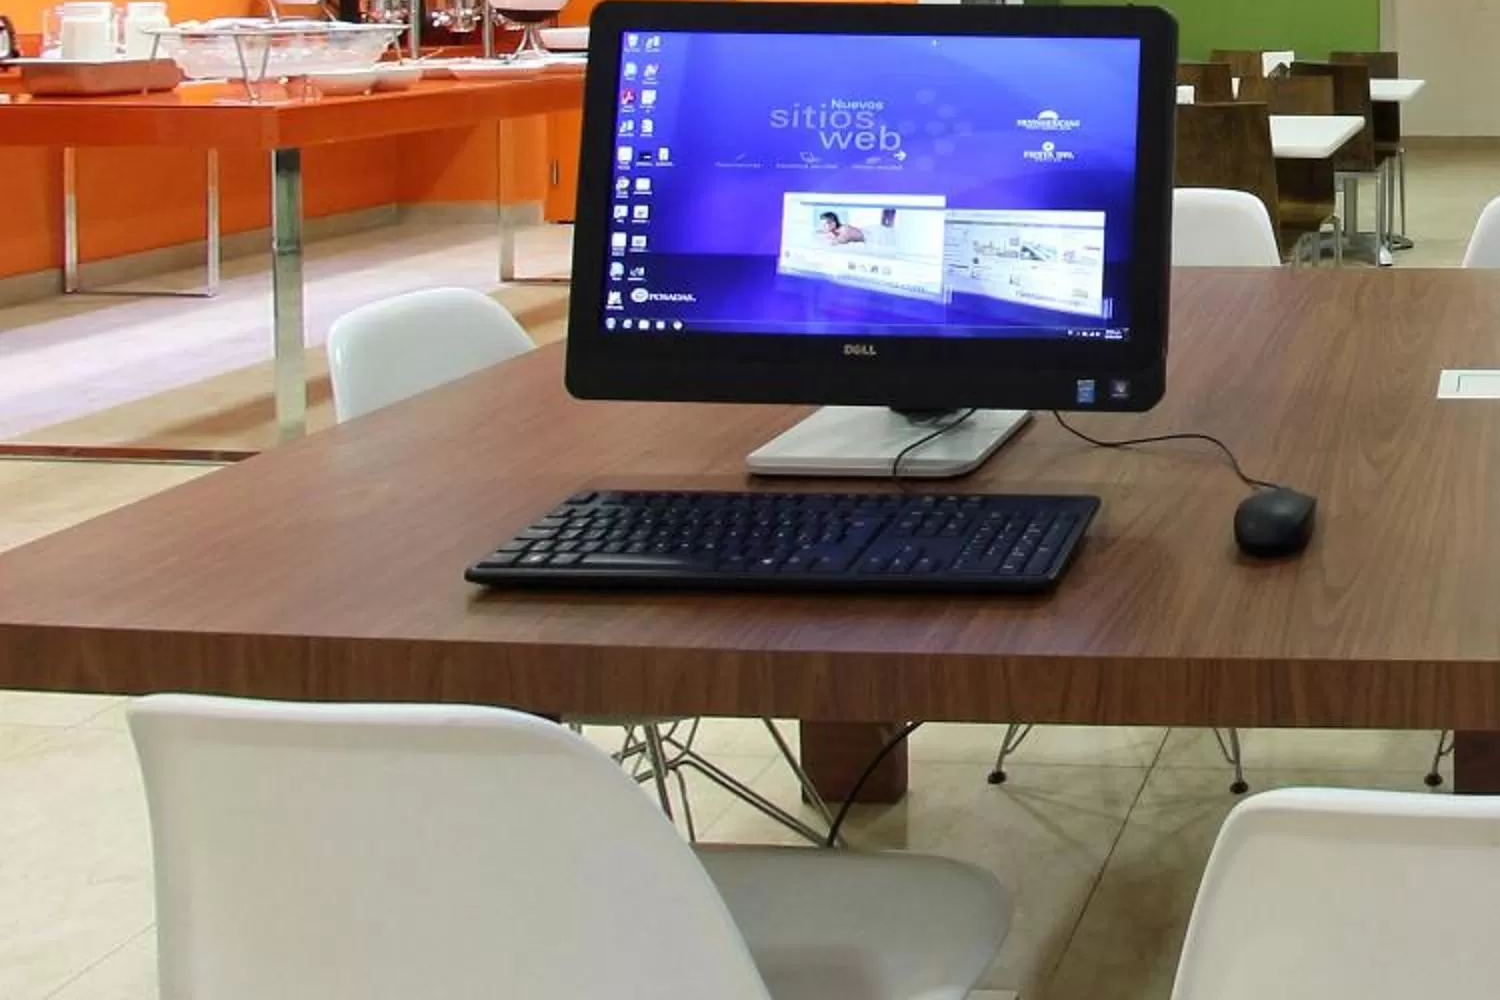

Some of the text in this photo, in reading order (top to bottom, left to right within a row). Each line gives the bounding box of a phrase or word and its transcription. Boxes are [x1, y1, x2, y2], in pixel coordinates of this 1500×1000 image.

[770, 103, 876, 130] sitios
[831, 98, 885, 111] Nuevos
[819, 125, 902, 151] web
